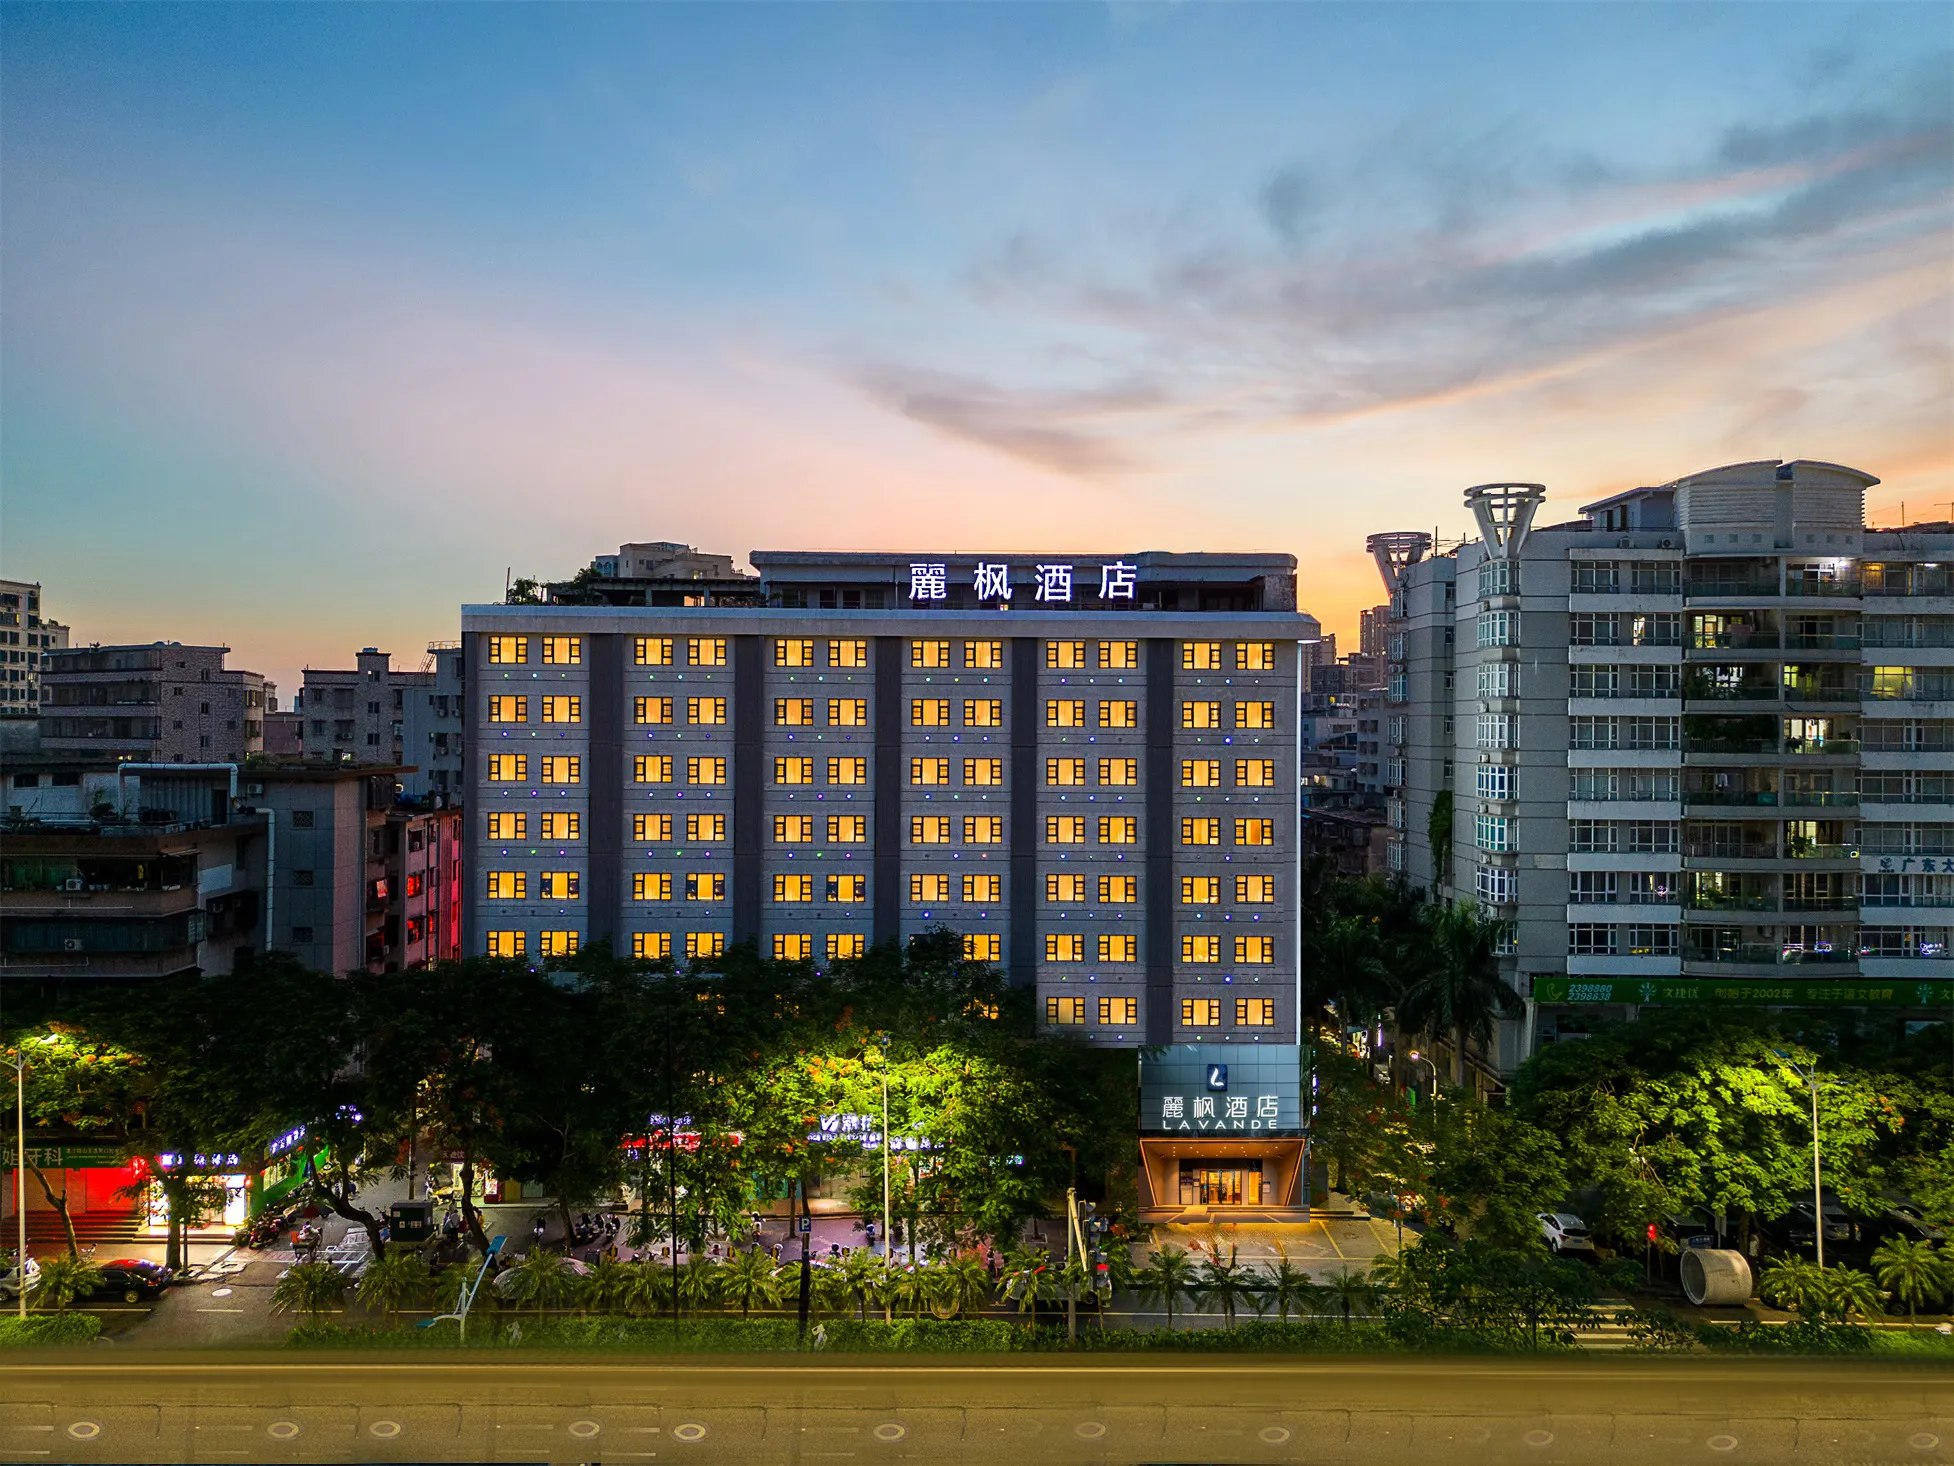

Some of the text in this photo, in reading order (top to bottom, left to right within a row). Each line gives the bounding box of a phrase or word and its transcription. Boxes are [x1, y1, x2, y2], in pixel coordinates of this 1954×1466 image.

[908, 561, 1137, 602] 麗枫酒店
[1162, 1095, 1279, 1119] 麗枫酒店
[1163, 1119, 1278, 1130] LAVANDE
[801, 1218, 810, 1230] P
